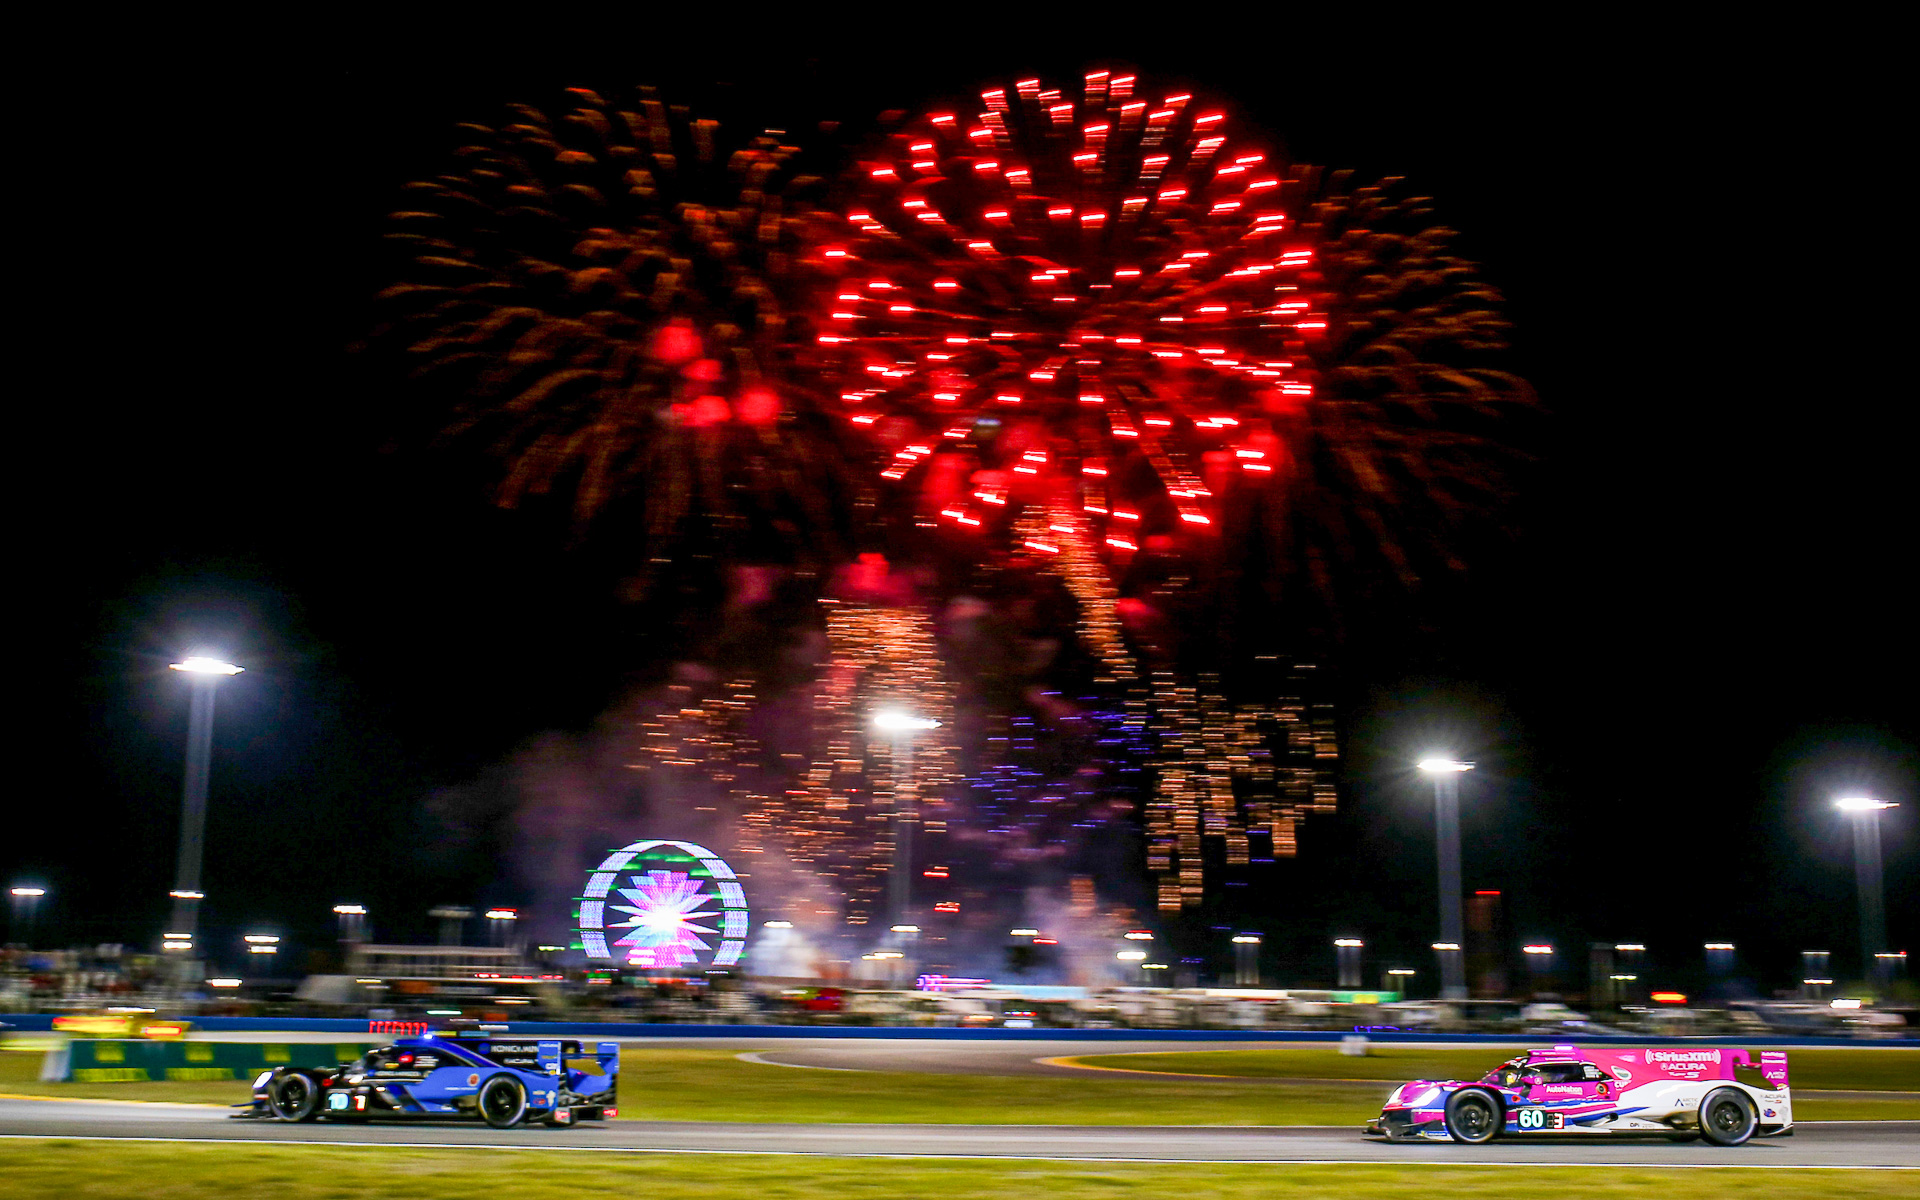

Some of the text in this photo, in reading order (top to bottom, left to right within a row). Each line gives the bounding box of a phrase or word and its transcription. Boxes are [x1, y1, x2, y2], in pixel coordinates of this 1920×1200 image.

[1668, 1062, 1707, 1070] ACURA
[1546, 1085, 1582, 1094] AutoNation
[328, 1093, 349, 1110] 10
[1519, 1109, 1544, 1128] 60
[1553, 1112, 1565, 1130] 3
